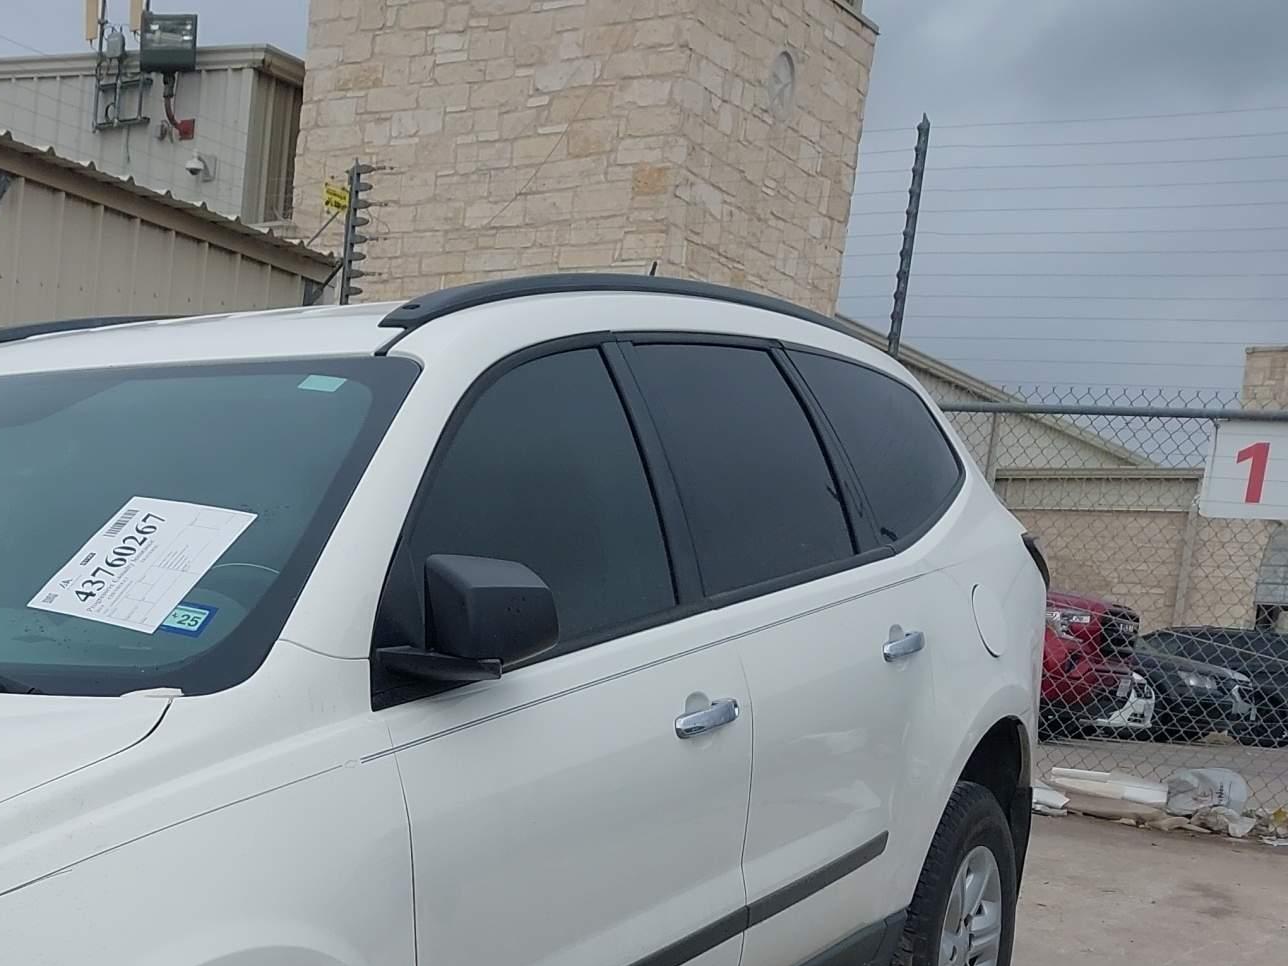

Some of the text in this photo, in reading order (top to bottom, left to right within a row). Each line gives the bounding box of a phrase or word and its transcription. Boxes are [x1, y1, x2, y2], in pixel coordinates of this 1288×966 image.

[1236, 442, 1271, 503] 1
[75, 512, 165, 602] 43760267
[176, 614, 202, 627] 25
